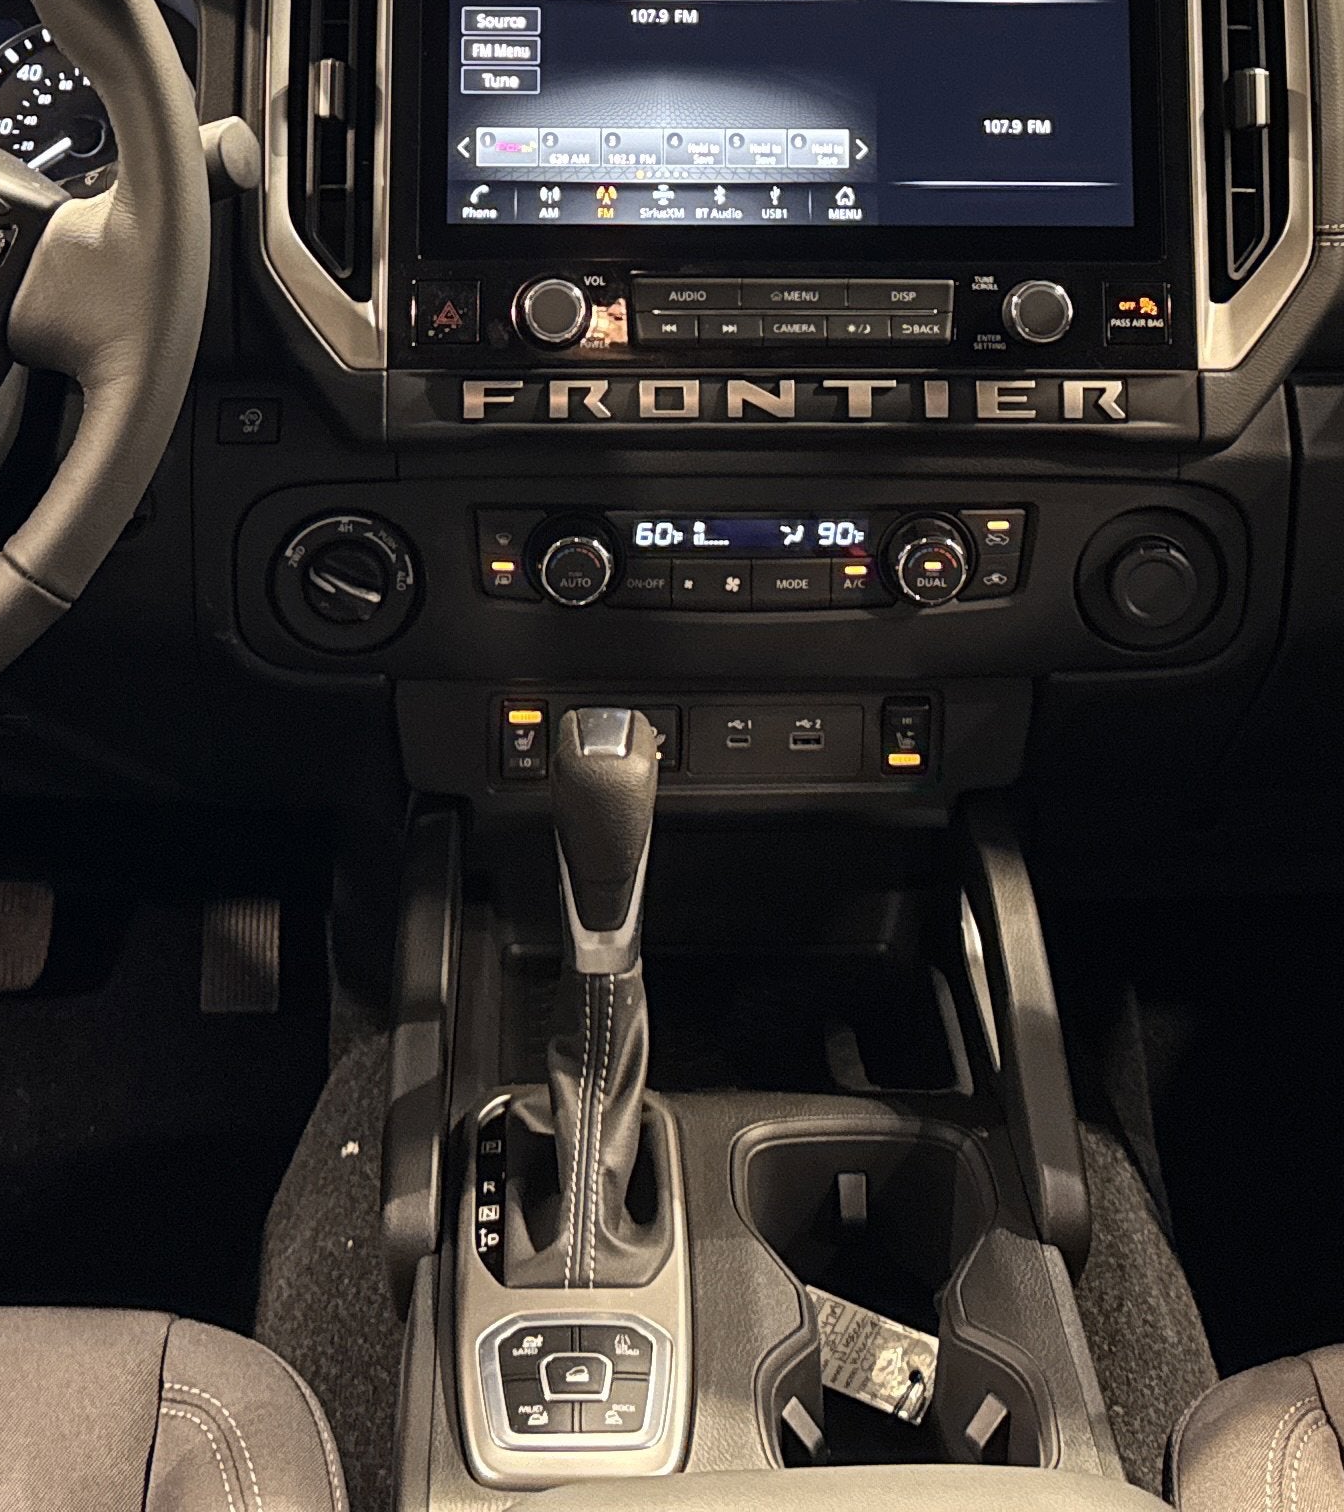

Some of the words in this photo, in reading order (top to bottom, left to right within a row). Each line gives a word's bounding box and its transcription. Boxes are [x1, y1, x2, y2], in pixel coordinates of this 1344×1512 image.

[476, 13, 527, 29] Source
[631, 9, 669, 24] 107.9
[674, 9, 698, 24] FM
[472, 43, 492, 58] FM
[494, 44, 531, 59] Menu
[16, 64, 43, 81] 40
[481, 72, 520, 88] Tune
[24, 116, 38, 126] 40
[983, 119, 1023, 134] 107.9
[1027, 119, 1051, 134] FM
[20, 141, 34, 151] 20
[462, 207, 498, 219] Phone
[538, 207, 559, 219] AM
[597, 207, 615, 219] FM
[639, 207, 685, 219] SiriusXM
[695, 208, 709, 219] BT
[710, 208, 743, 219] Audio
[761, 208, 788, 219] USB1
[828, 208, 862, 220] MENU
[584, 276, 606, 286] VOL
[669, 291, 706, 301] AUDIO
[783, 291, 819, 302] MENU
[891, 291, 916, 302] DISP
[1119, 302, 1136, 310] OFF
[773, 323, 816, 333] CAMERA
[913, 324, 940, 333] BACK
[1111, 319, 1130, 327] PASS
[1132, 319, 1146, 327] AIR
[1147, 319, 1164, 327] BAG
[973, 342, 1006, 351] SETTING
[463, 380, 1126, 419] FRONTIER
[338, 523, 353, 533] 4H
[288, 545, 305, 568] 2WD
[396, 571, 406, 591] 4LO
[560, 577, 592, 588] AUTO
[776, 579, 809, 589] MODE
[843, 579, 866, 589] A/C
[917, 578, 947, 587] DUAL
[519, 757, 532, 768] LO
[483, 1181, 496, 1194] R
[488, 1233, 499, 1245] D
[512, 1348, 539, 1356] SAND
[518, 1405, 543, 1413] MUD
[612, 1403, 635, 1412] ROCK
